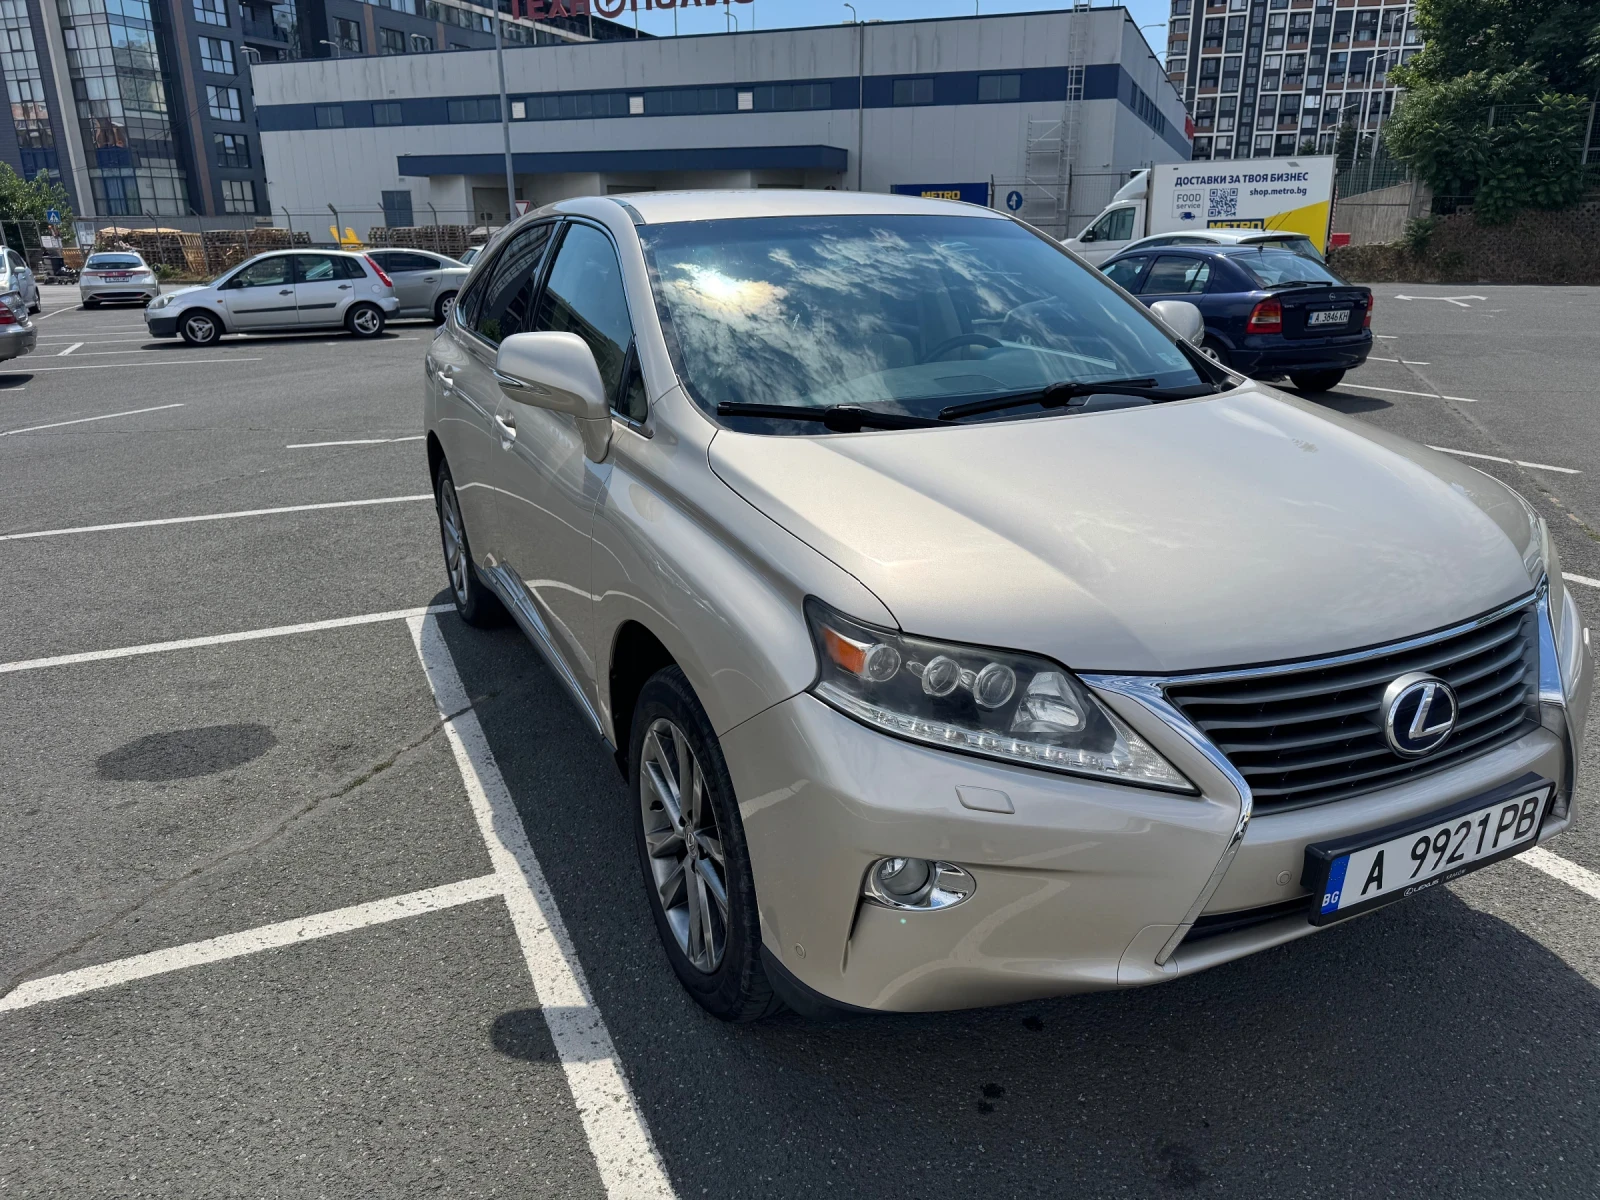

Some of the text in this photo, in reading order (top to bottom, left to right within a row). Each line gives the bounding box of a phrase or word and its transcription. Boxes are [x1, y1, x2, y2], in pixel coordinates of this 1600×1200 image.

[1175, 172, 1309, 187] ДОСТАВКИ ЗА ТВОЯ БИЗНЕС
[921, 191, 960, 200] METRO
[1176, 193, 1201, 202] FOOD
[1250, 187, 1307, 197] shop.metro.bg
[1361, 796, 1539, 896] A 9921 PB
[1321, 890, 1339, 907] BG
